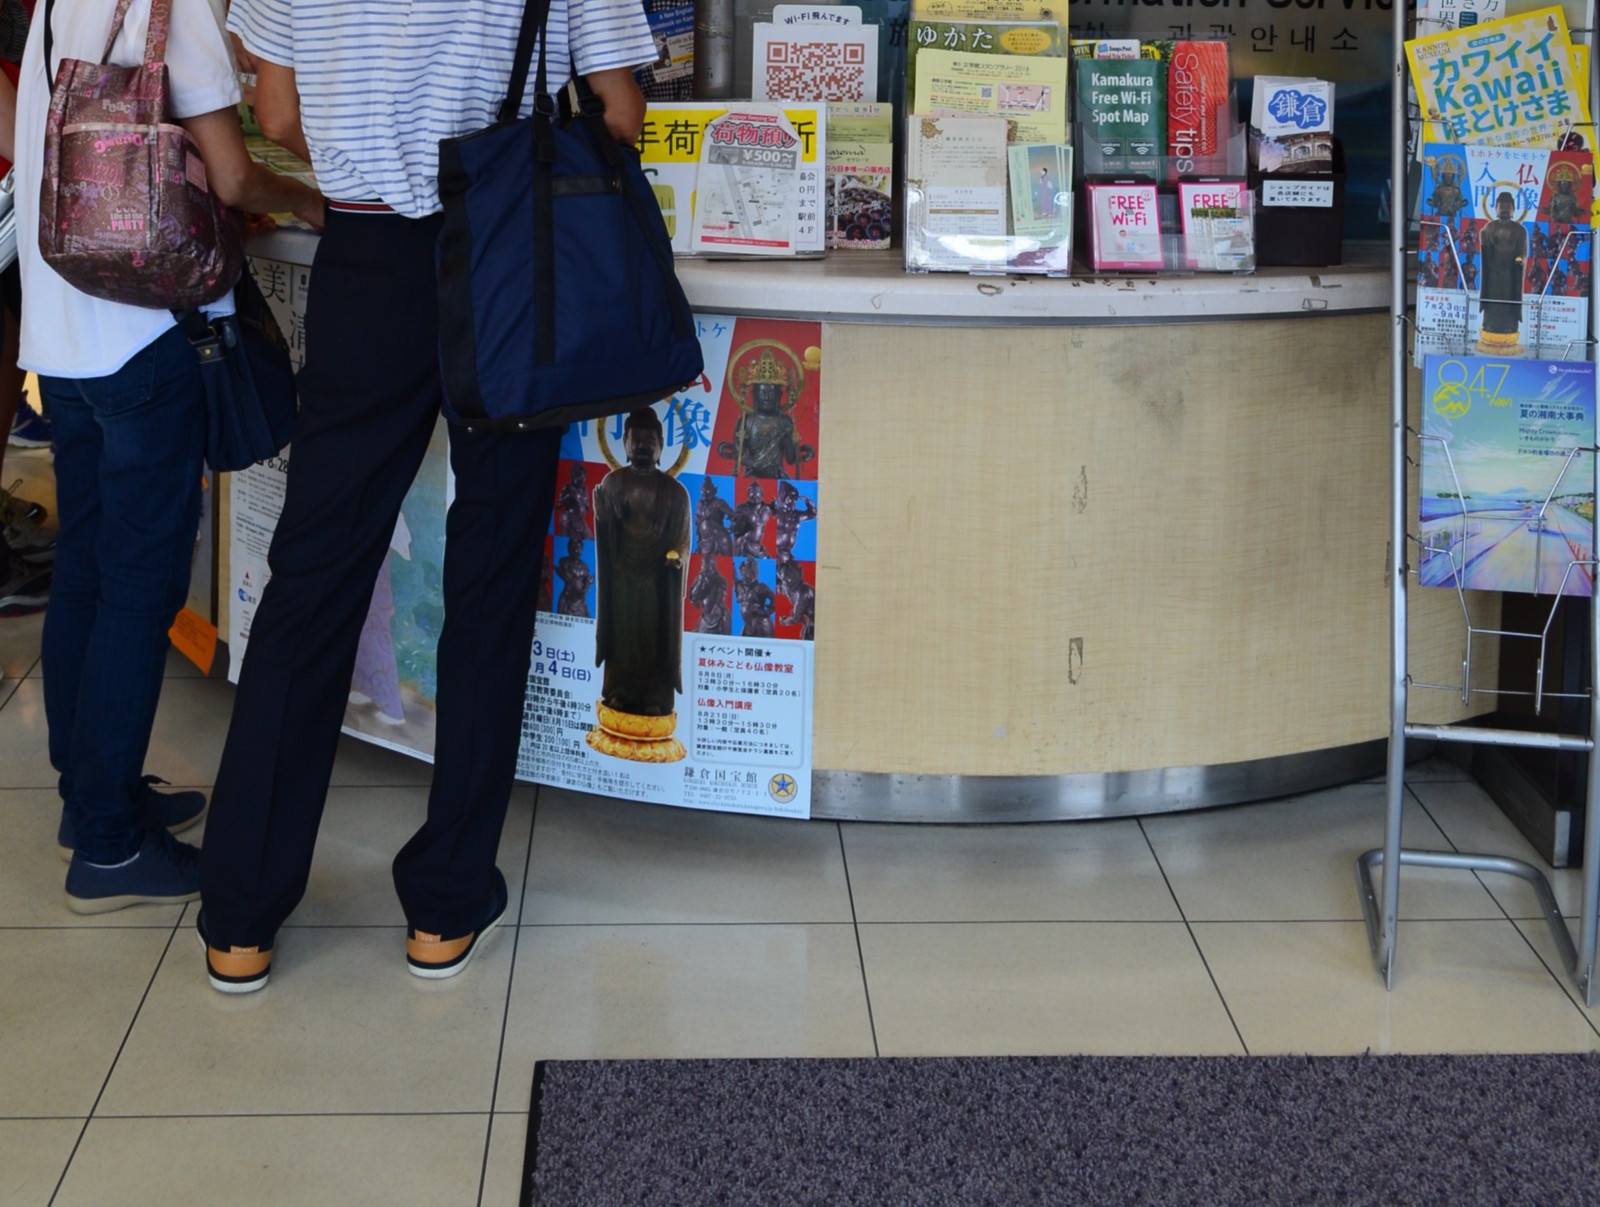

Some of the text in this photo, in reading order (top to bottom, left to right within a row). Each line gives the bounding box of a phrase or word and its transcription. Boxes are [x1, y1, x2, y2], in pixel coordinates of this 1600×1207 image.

[916, 25, 993, 50] ゆかた
[1073, 47, 1090, 56] WIN
[1415, 40, 1450, 54] KANNON
[1417, 47, 1452, 61] MUSEUM
[1429, 32, 1555, 87] カワイイ
[1015, 64, 1030, 72] 2016
[1091, 72, 1154, 87] Kamakura
[1434, 60, 1565, 113] Kawaii
[1092, 91, 1152, 105] Free Wi-Fi
[1092, 109, 1149, 126] Spot Map
[1170, 52, 1199, 174] Safety tips
[1270, 92, 1325, 127] 鎌倉
[1442, 89, 1572, 141] ほとけさま
[711, 122, 798, 149] 荷物預り
[1470, 149, 1548, 162] ミホトケをヒモトケ
[1474, 161, 1498, 208] 入門
[1516, 163, 1540, 210] 仏像
[798, 199, 816, 208] まで
[1108, 194, 1146, 210] FREE
[1193, 193, 1229, 209] FREE
[797, 212, 816, 221] 駅前
[1110, 211, 1147, 226] Wi-Fi
[111, 219, 145, 232] PARTY
[1520, 409, 1585, 421] 夏の湘南大事典
[697, 657, 794, 674] 夏休みこども仏像教室
[697, 698, 754, 711] 仏像入門講座
[684, 766, 758, 783] 鎌倉国宝館
